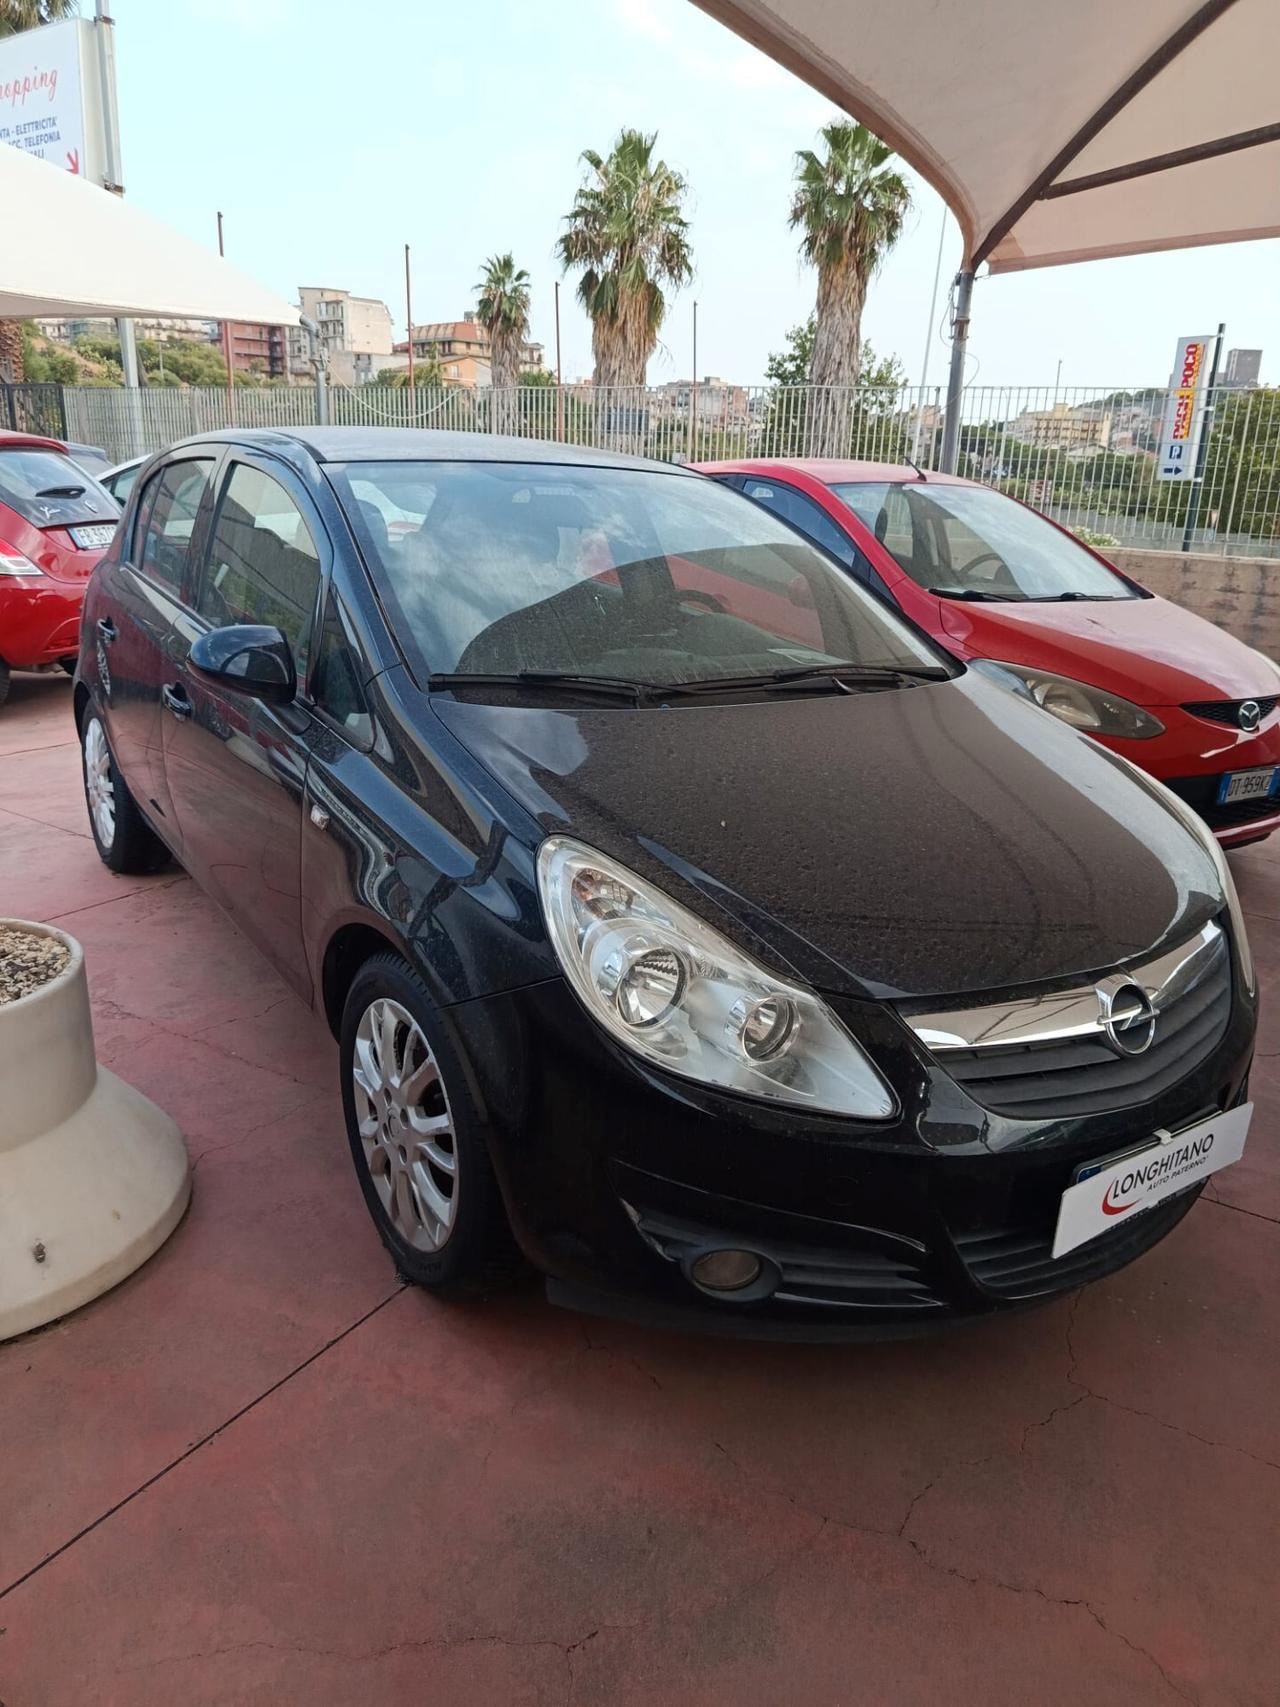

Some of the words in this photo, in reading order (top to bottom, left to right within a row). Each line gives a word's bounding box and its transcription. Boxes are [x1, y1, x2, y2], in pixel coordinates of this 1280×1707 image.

[24, 131, 60, 147] TELEFONIA
[1180, 343, 1199, 388] POCO
[1113, 1133, 1215, 1200] LONGHITANO
[1147, 1175, 1169, 1192] AUTO
